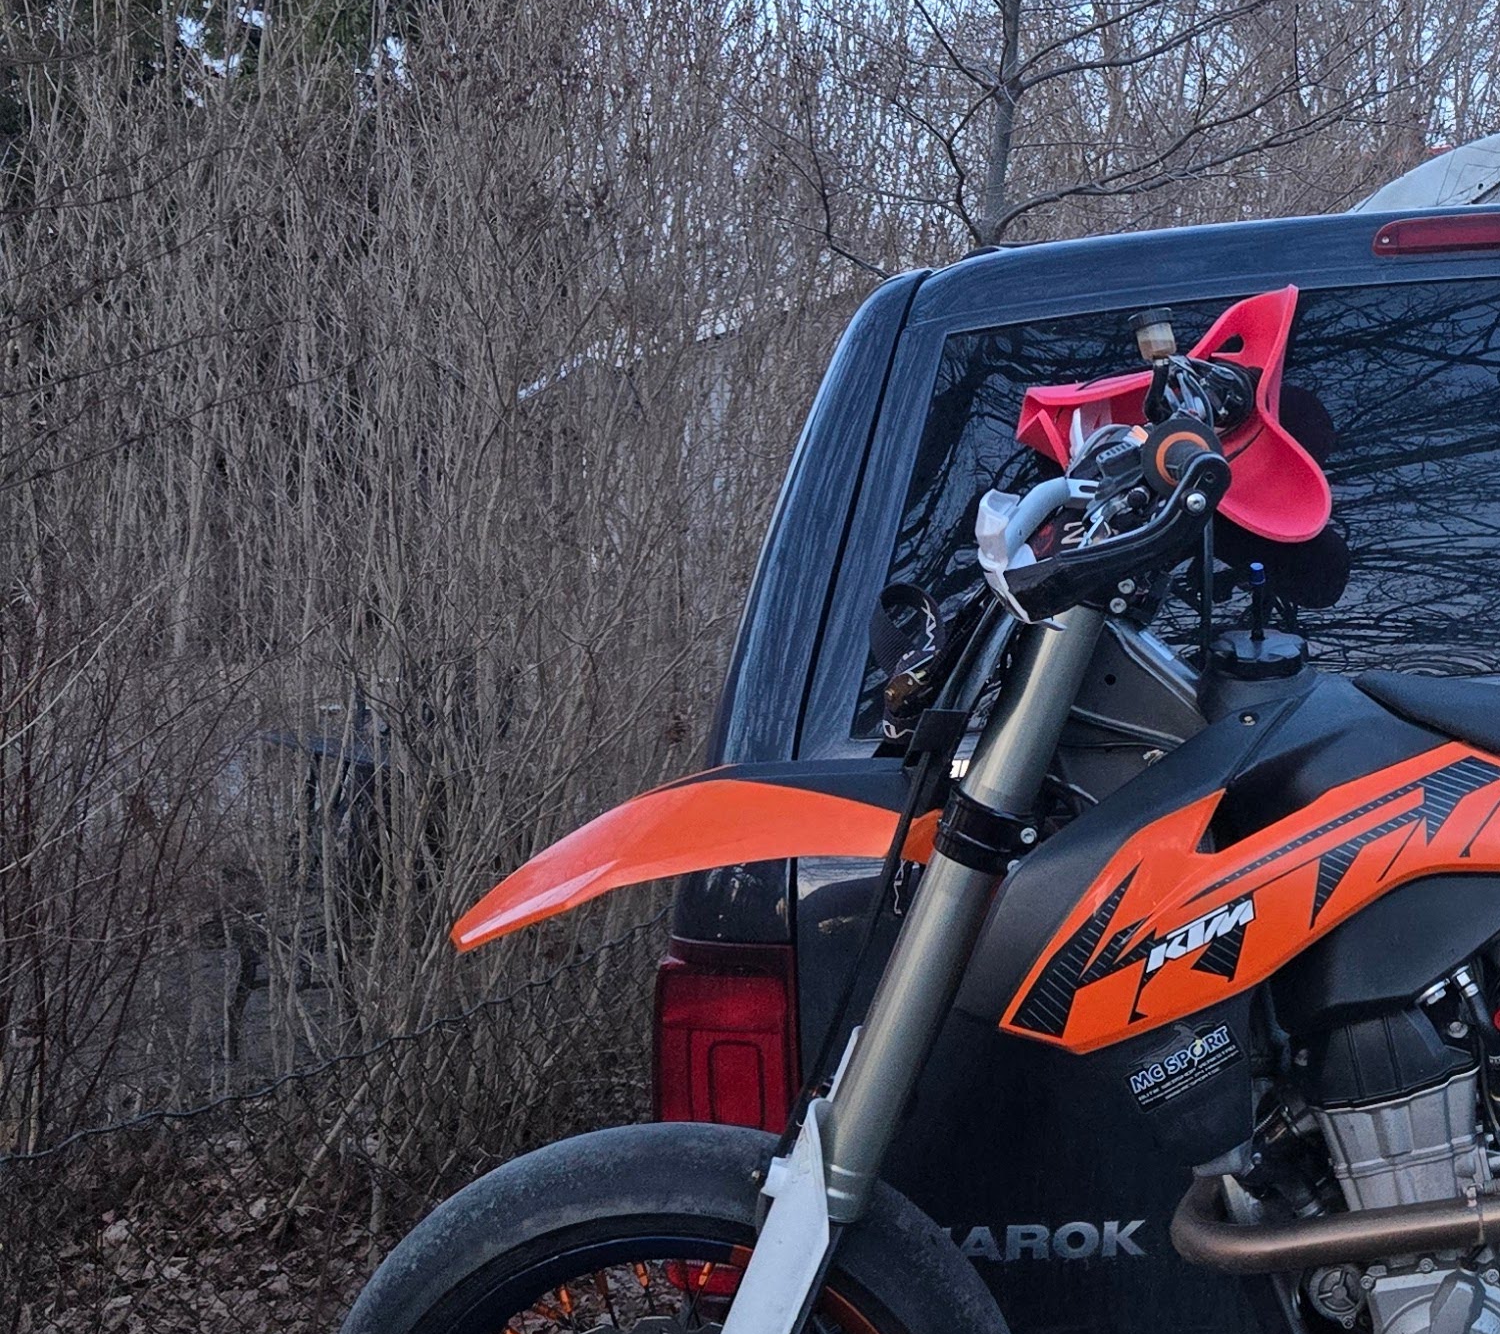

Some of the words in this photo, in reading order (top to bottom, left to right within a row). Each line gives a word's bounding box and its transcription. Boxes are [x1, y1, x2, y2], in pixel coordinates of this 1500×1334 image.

[1146, 899, 1255, 974] KTM
[1130, 1063, 1167, 1094] MC
[1164, 1025, 1231, 1075] SPORT
[942, 1219, 1149, 1262] AROK
